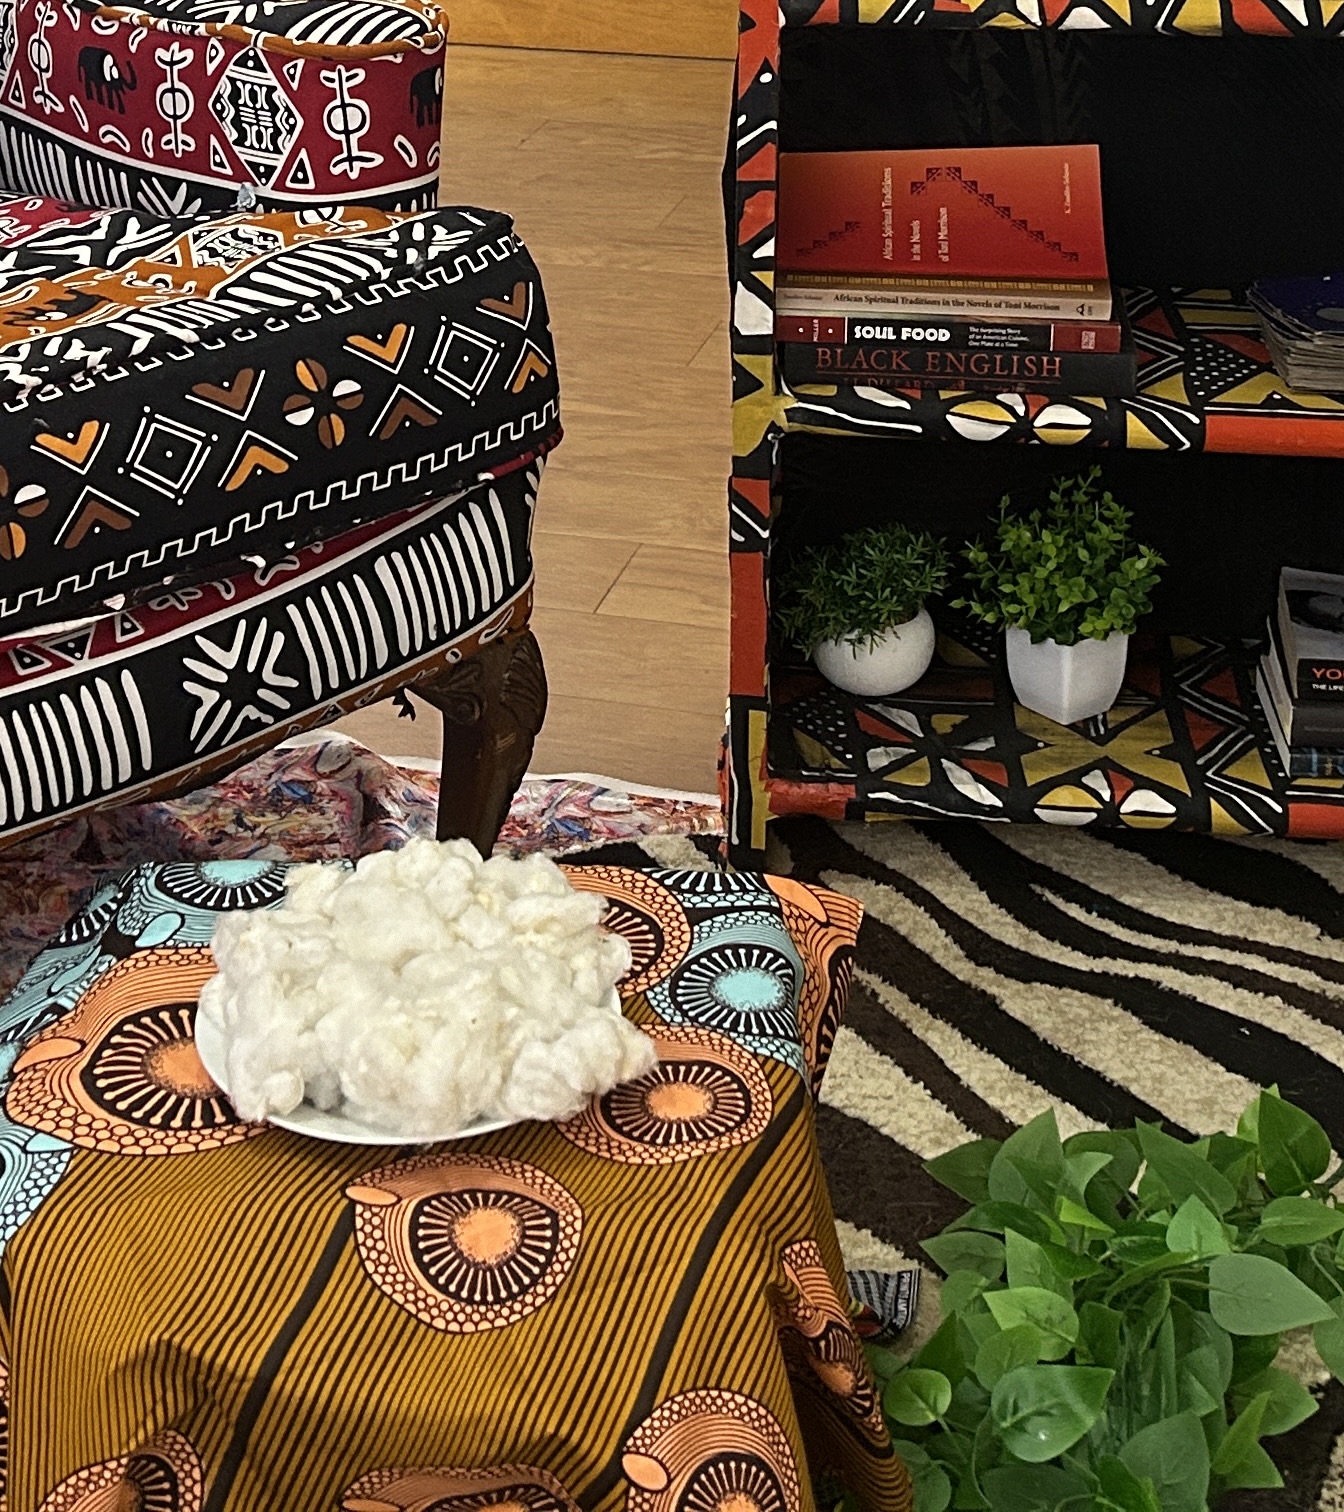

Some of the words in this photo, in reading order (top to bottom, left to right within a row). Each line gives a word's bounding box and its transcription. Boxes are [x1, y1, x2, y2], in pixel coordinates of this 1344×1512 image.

[881, 167, 892, 208] Traditions
[881, 208, 894, 237] Spiritual
[937, 207, 949, 240] Morrison
[882, 238, 893, 260] African
[833, 293, 863, 303] African
[864, 295, 899, 306] Spiritual
[900, 296, 940, 307] Traditions
[1023, 302, 1061, 311] Morrison
[854, 324, 896, 340] SOUL
[901, 327, 951, 342] FOOD
[816, 347, 912, 371] BLACK
[925, 350, 1063, 378] ENGLISH
